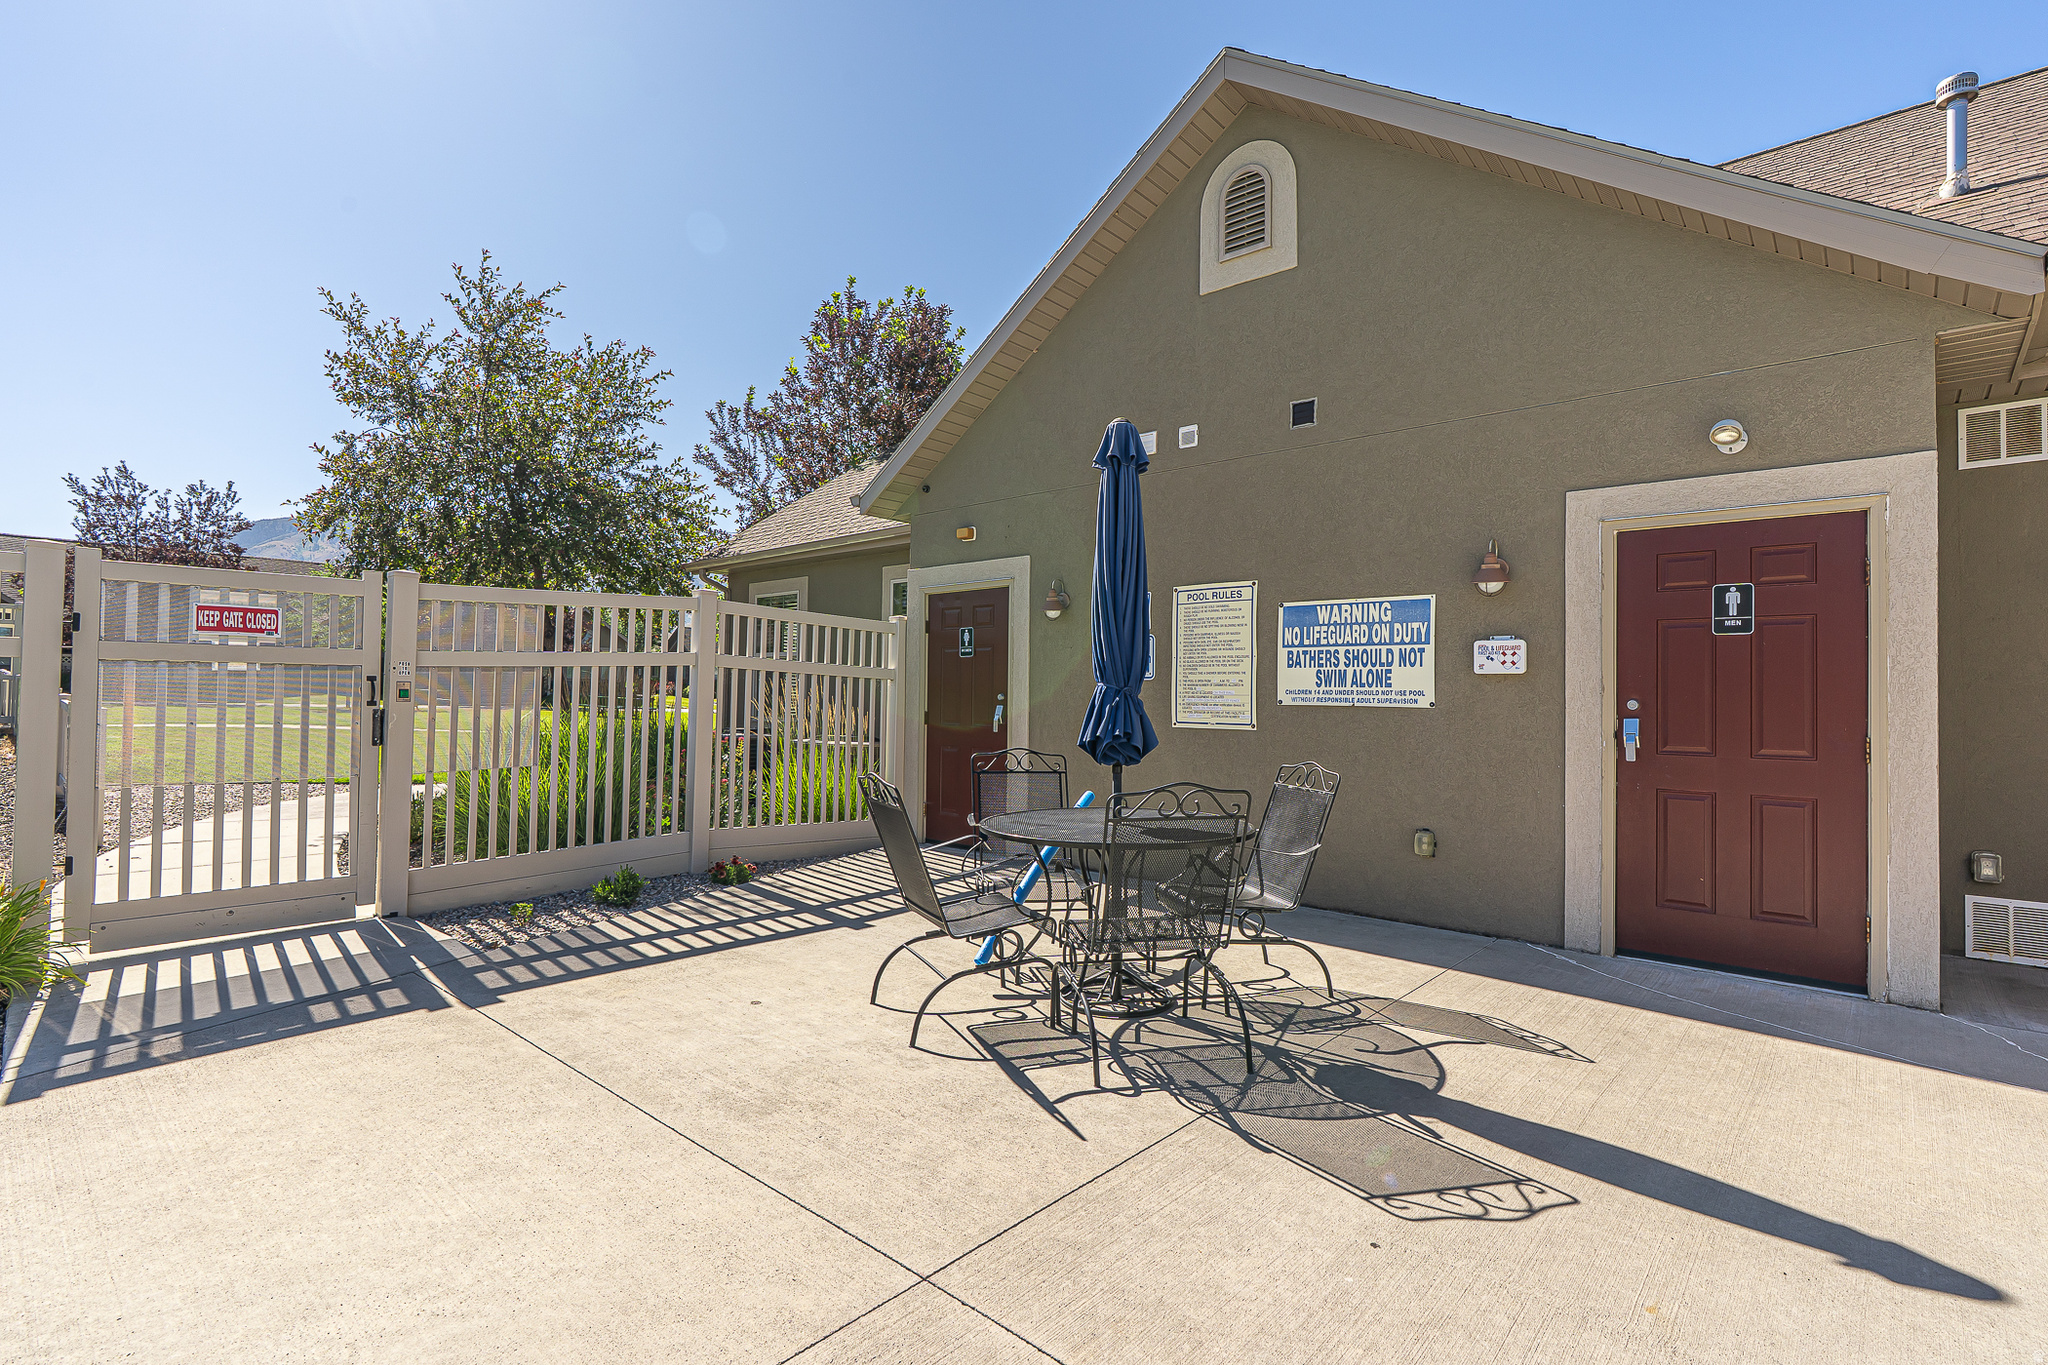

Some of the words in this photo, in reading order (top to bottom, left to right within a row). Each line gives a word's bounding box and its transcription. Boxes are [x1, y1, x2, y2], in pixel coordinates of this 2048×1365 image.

[1187, 592, 1209, 601] POOL
[1212, 590, 1243, 599] RULES
[198, 610, 220, 627] KEEP
[222, 611, 244, 628] GATE
[246, 612, 277, 630] CLOSED
[1317, 601, 1392, 624] WARNING
[1284, 626, 1300, 646] NO
[1303, 624, 1368, 645] LIFEGUARD
[1371, 623, 1390, 644] ON
[1394, 621, 1428, 643] DUTY
[1287, 649, 1340, 668] BATHERS
[1344, 648, 1394, 668] SHOULD
[1399, 647, 1426, 667] NOT
[1315, 669, 1347, 688] SWIM
[1350, 668, 1392, 688] ALONE
[1376, 697, 1418, 705] SUPERVISION
